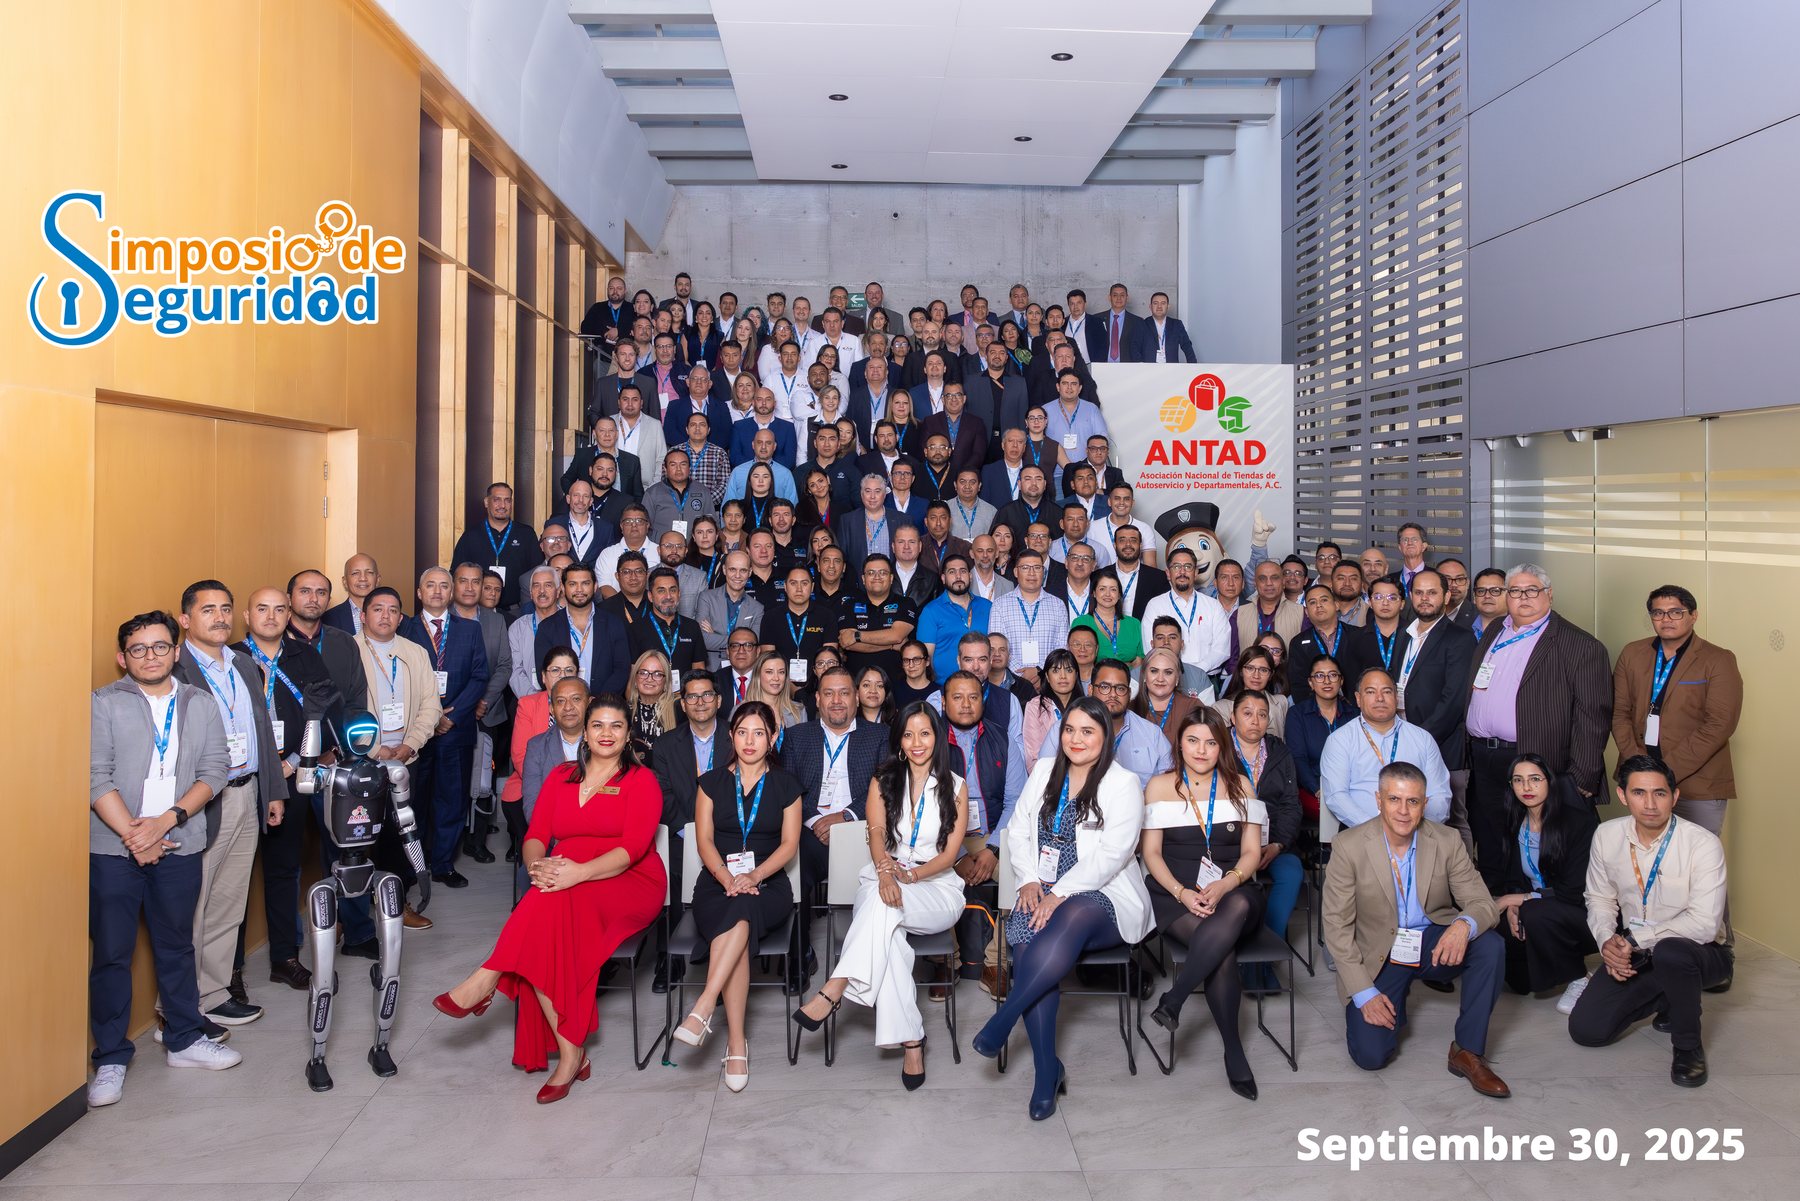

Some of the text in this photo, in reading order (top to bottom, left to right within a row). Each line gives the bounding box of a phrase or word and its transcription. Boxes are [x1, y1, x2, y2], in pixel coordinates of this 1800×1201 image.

[1144, 439, 1267, 466] ANTAD
[1139, 471, 1276, 479] Asociación Nacional de Tiendas de
[1135, 481, 1282, 491] Autoservicio y Departamentales, A.C.
